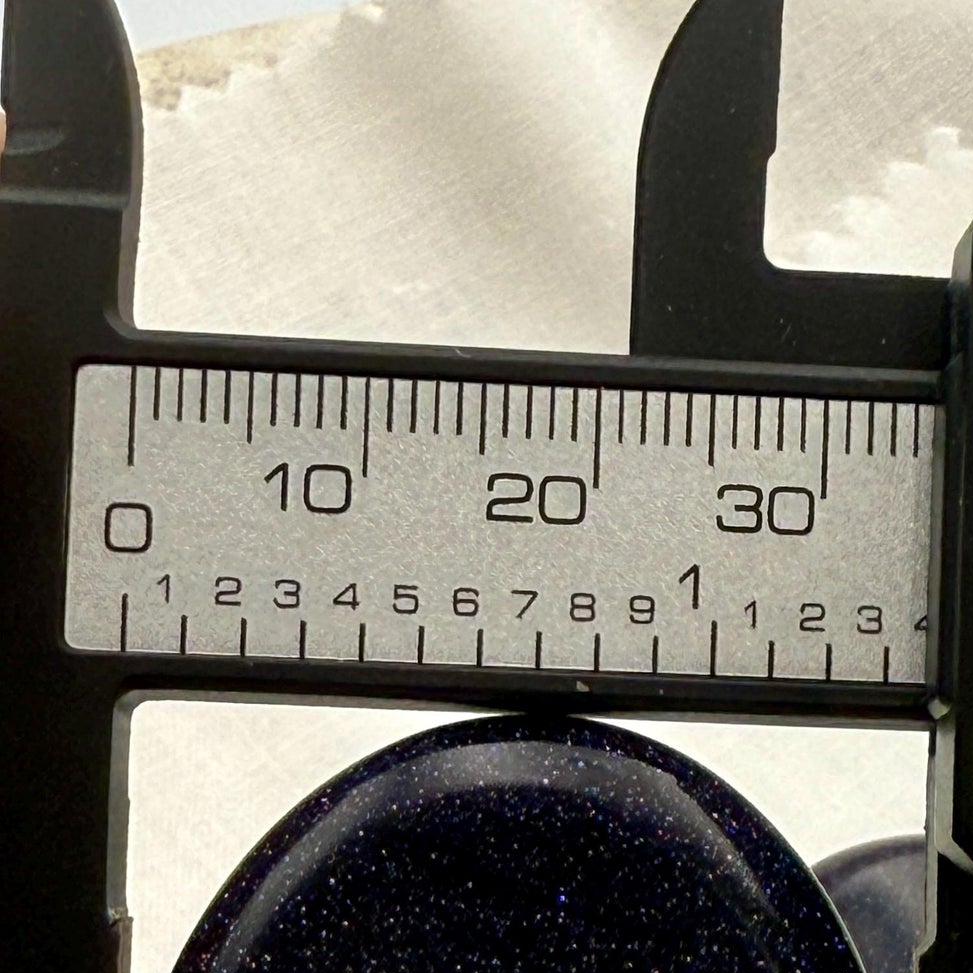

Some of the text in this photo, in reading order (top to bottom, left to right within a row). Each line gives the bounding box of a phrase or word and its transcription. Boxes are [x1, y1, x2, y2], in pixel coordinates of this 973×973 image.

[105, 502, 153, 553] 0
[264, 462, 815, 535] 10 20 30
[156, 574, 171, 603] 1
[214, 577, 242, 606] 2
[273, 580, 301, 609] 3
[333, 583, 360, 611] 4
[393, 585, 419, 614] 5
[452, 588, 480, 617] 6
[511, 590, 538, 618] 7
[569, 593, 596, 622] 8
[629, 595, 655, 624] 9
[679, 564, 700, 610] 1
[744, 600, 758, 629] 1
[799, 603, 826, 632] 2
[857, 605, 883, 634] 3
